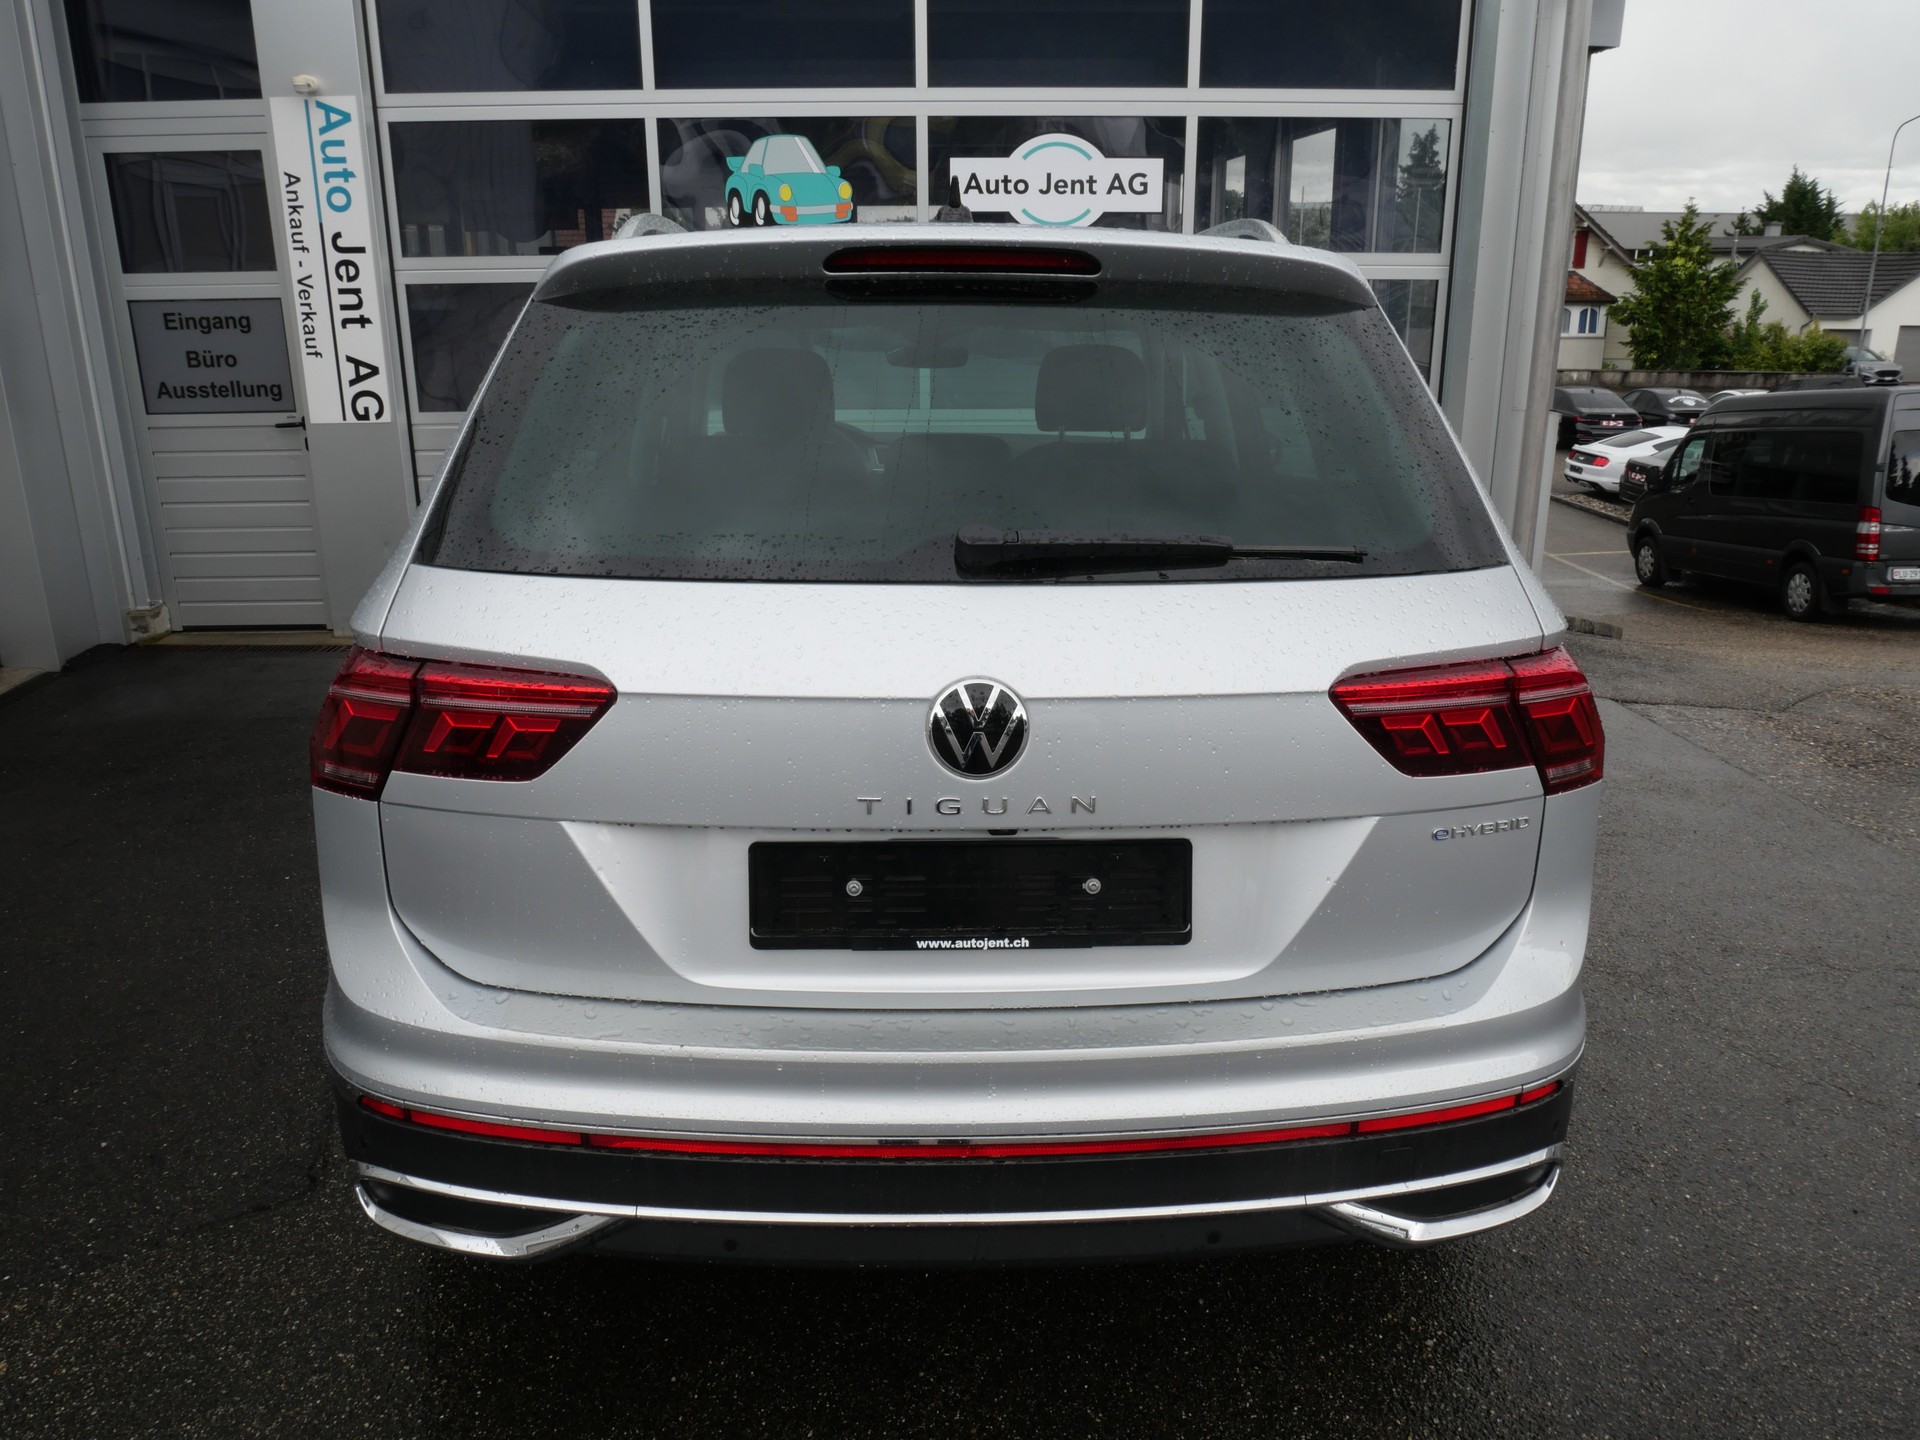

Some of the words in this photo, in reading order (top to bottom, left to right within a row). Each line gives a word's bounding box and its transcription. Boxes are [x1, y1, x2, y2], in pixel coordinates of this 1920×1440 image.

[315, 100, 357, 213] Auto
[963, 172, 1029, 195] Auto
[1038, 172, 1097, 195] Jent
[1106, 172, 1149, 195] AG
[283, 171, 310, 253] Ankauf
[297, 274, 323, 358] Verkauf
[331, 231, 374, 329] Jent
[163, 312, 252, 333] Eingang
[185, 349, 238, 369] Büro
[157, 380, 283, 401] Ausstellung
[345, 354, 385, 422] AG
[856, 796, 1097, 816] TIGUAN
[916, 937, 1030, 950] www.autojent.ch
